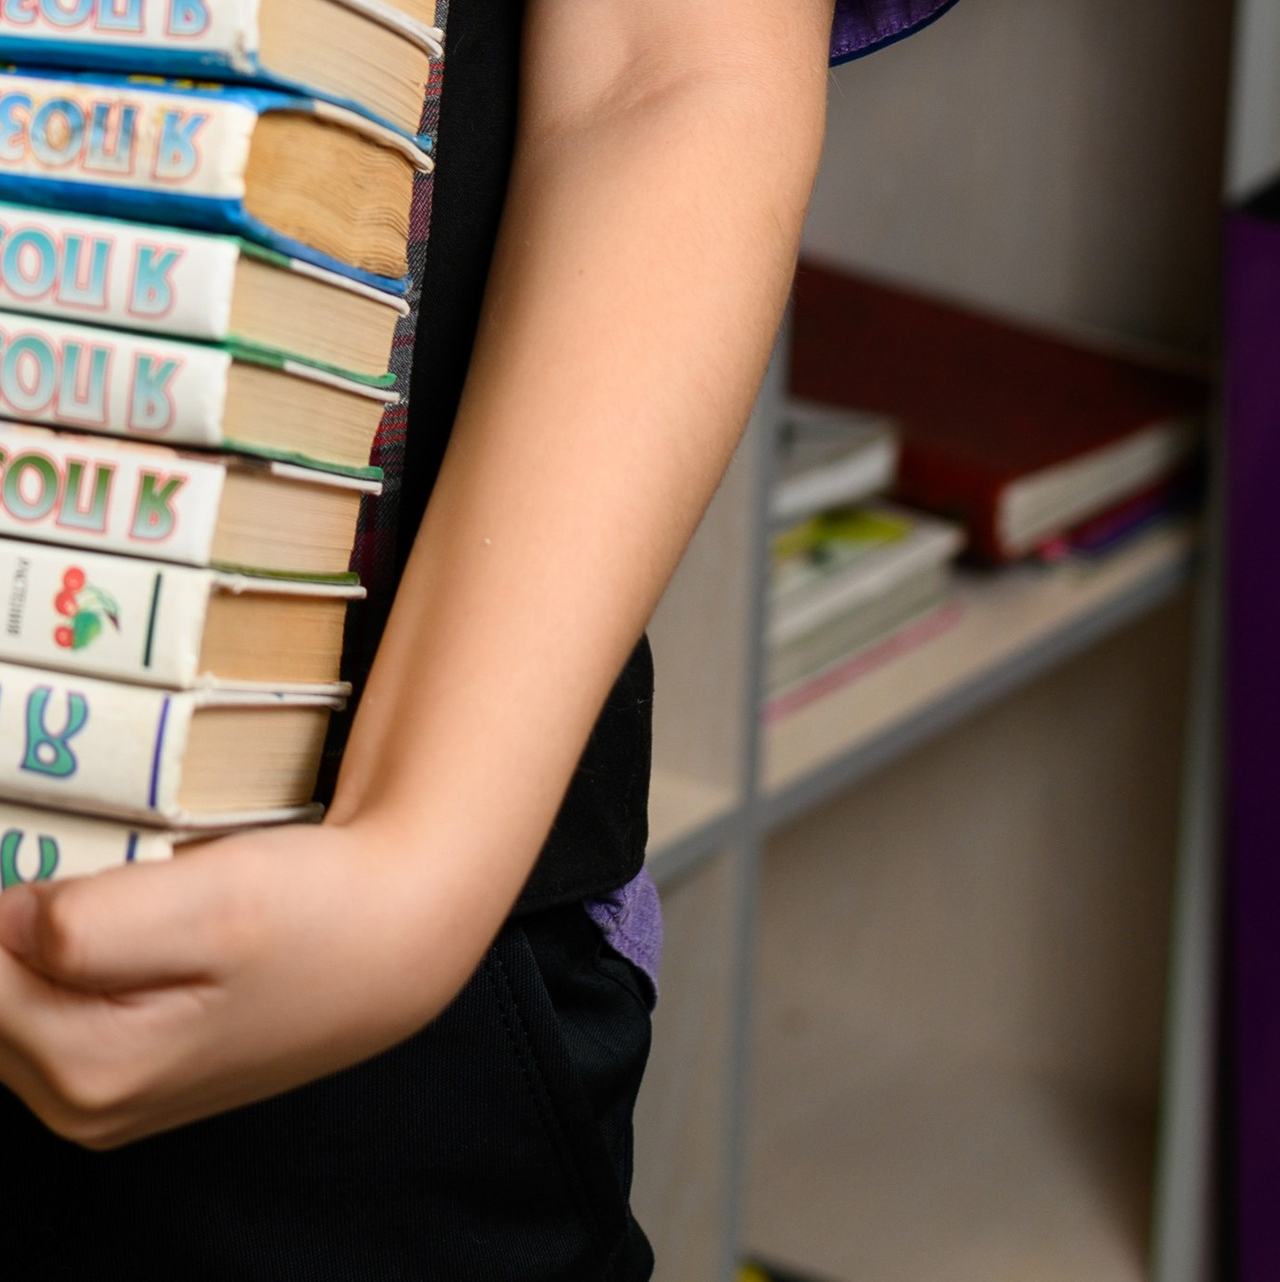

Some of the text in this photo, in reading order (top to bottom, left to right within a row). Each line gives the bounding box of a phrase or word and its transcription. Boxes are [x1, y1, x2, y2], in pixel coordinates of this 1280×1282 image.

[150, 107, 209, 184] Я
[127, 241, 185, 318] Я
[127, 350, 185, 434] Я
[128, 467, 189, 543] Я
[21, 684, 89, 778] Я
